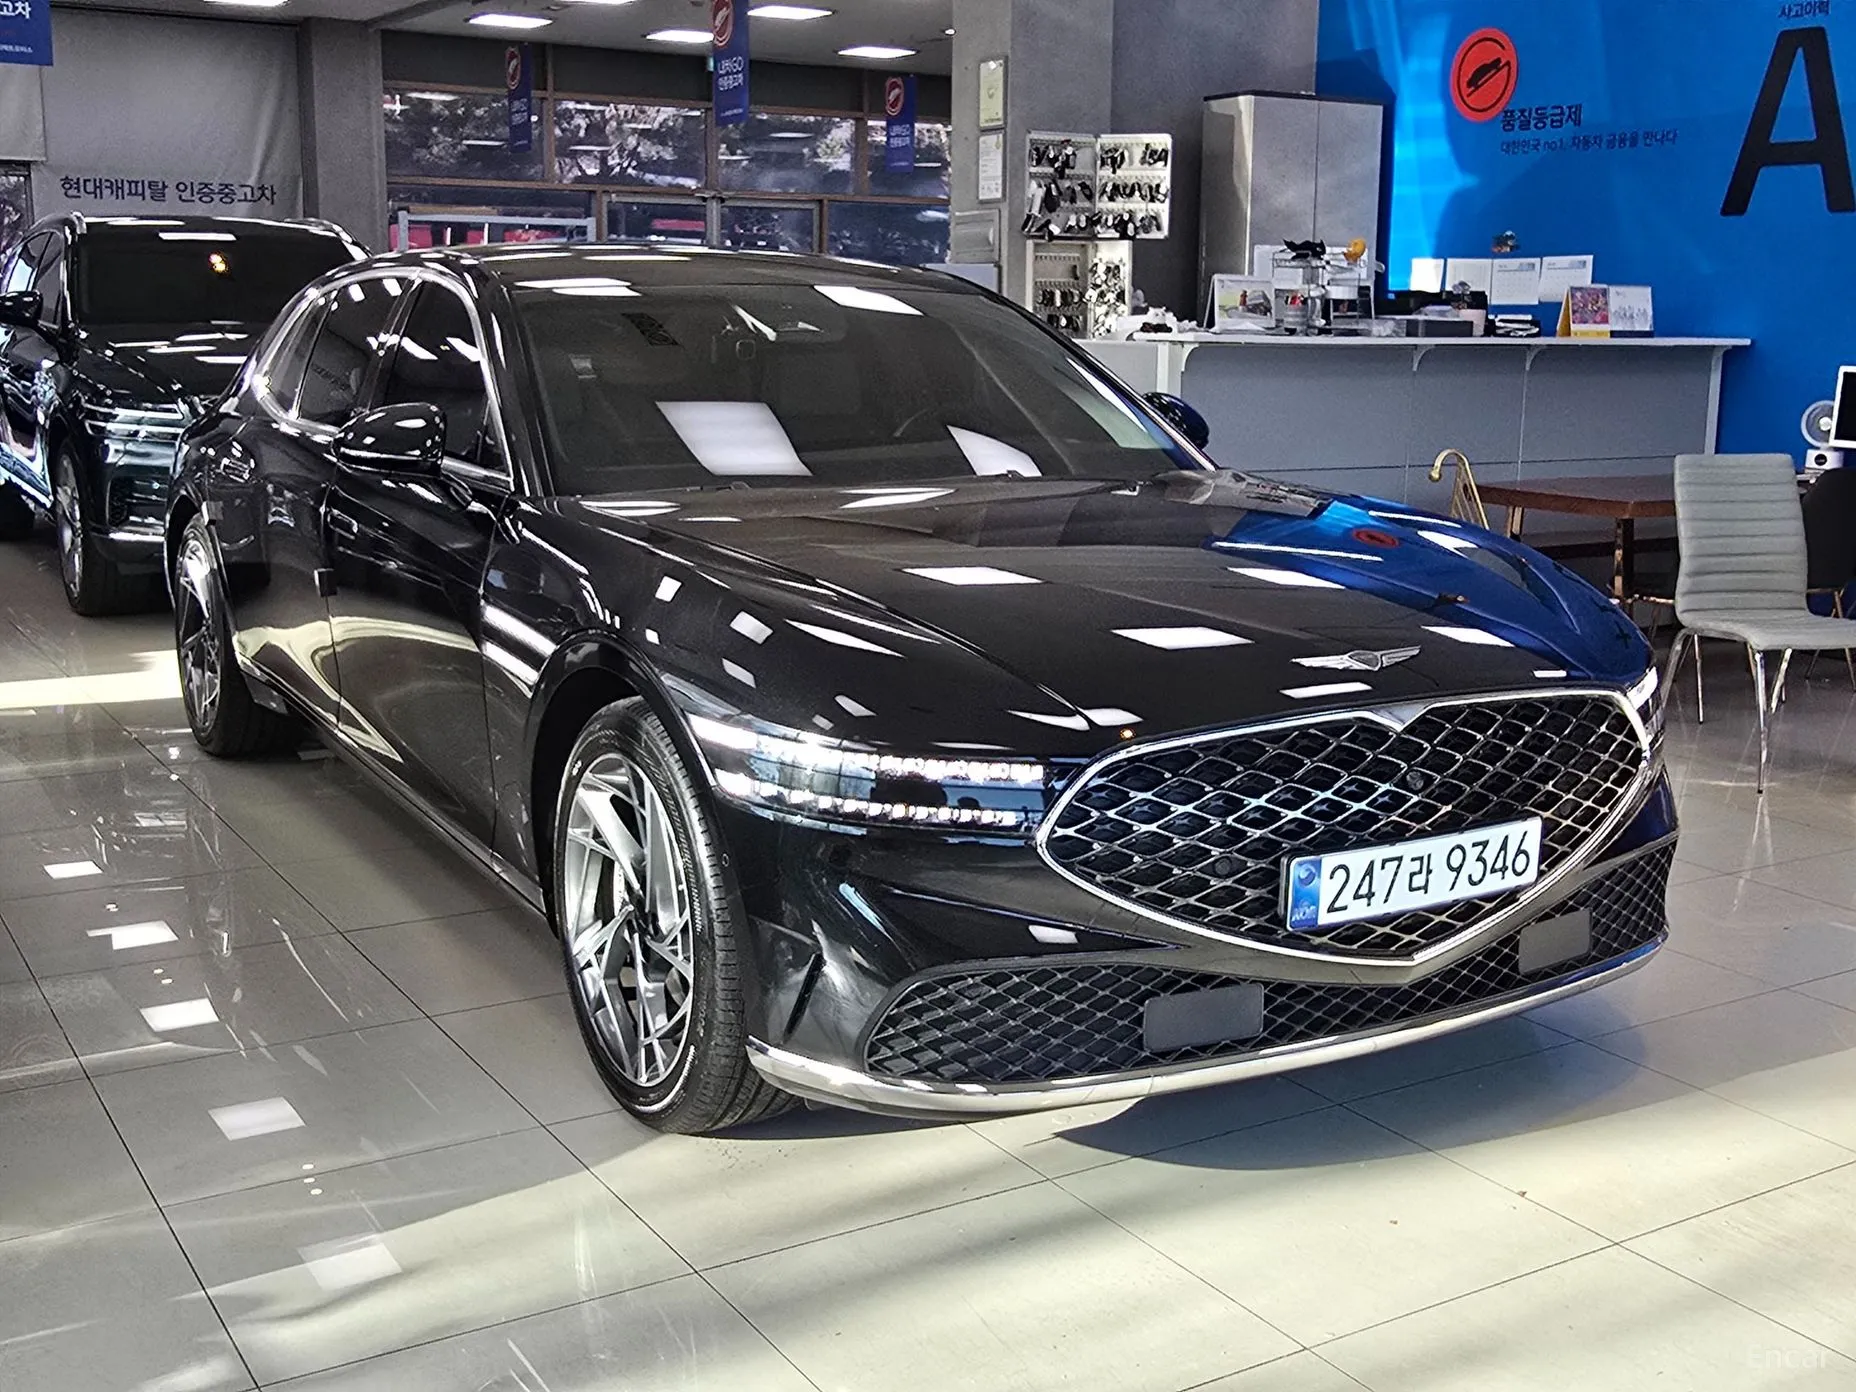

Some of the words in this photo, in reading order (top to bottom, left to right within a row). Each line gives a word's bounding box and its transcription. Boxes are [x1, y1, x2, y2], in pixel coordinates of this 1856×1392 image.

[1778, 0, 1830, 18] 사고이력
[1501, 104, 1582, 132] 품질등급제
[1720, 26, 1855, 216] A
[60, 176, 168, 202] 현대캐피탈
[176, 181, 276, 205] 인증중고차
[1326, 853, 1433, 914] 247라
[1446, 831, 1531, 892] 9346
